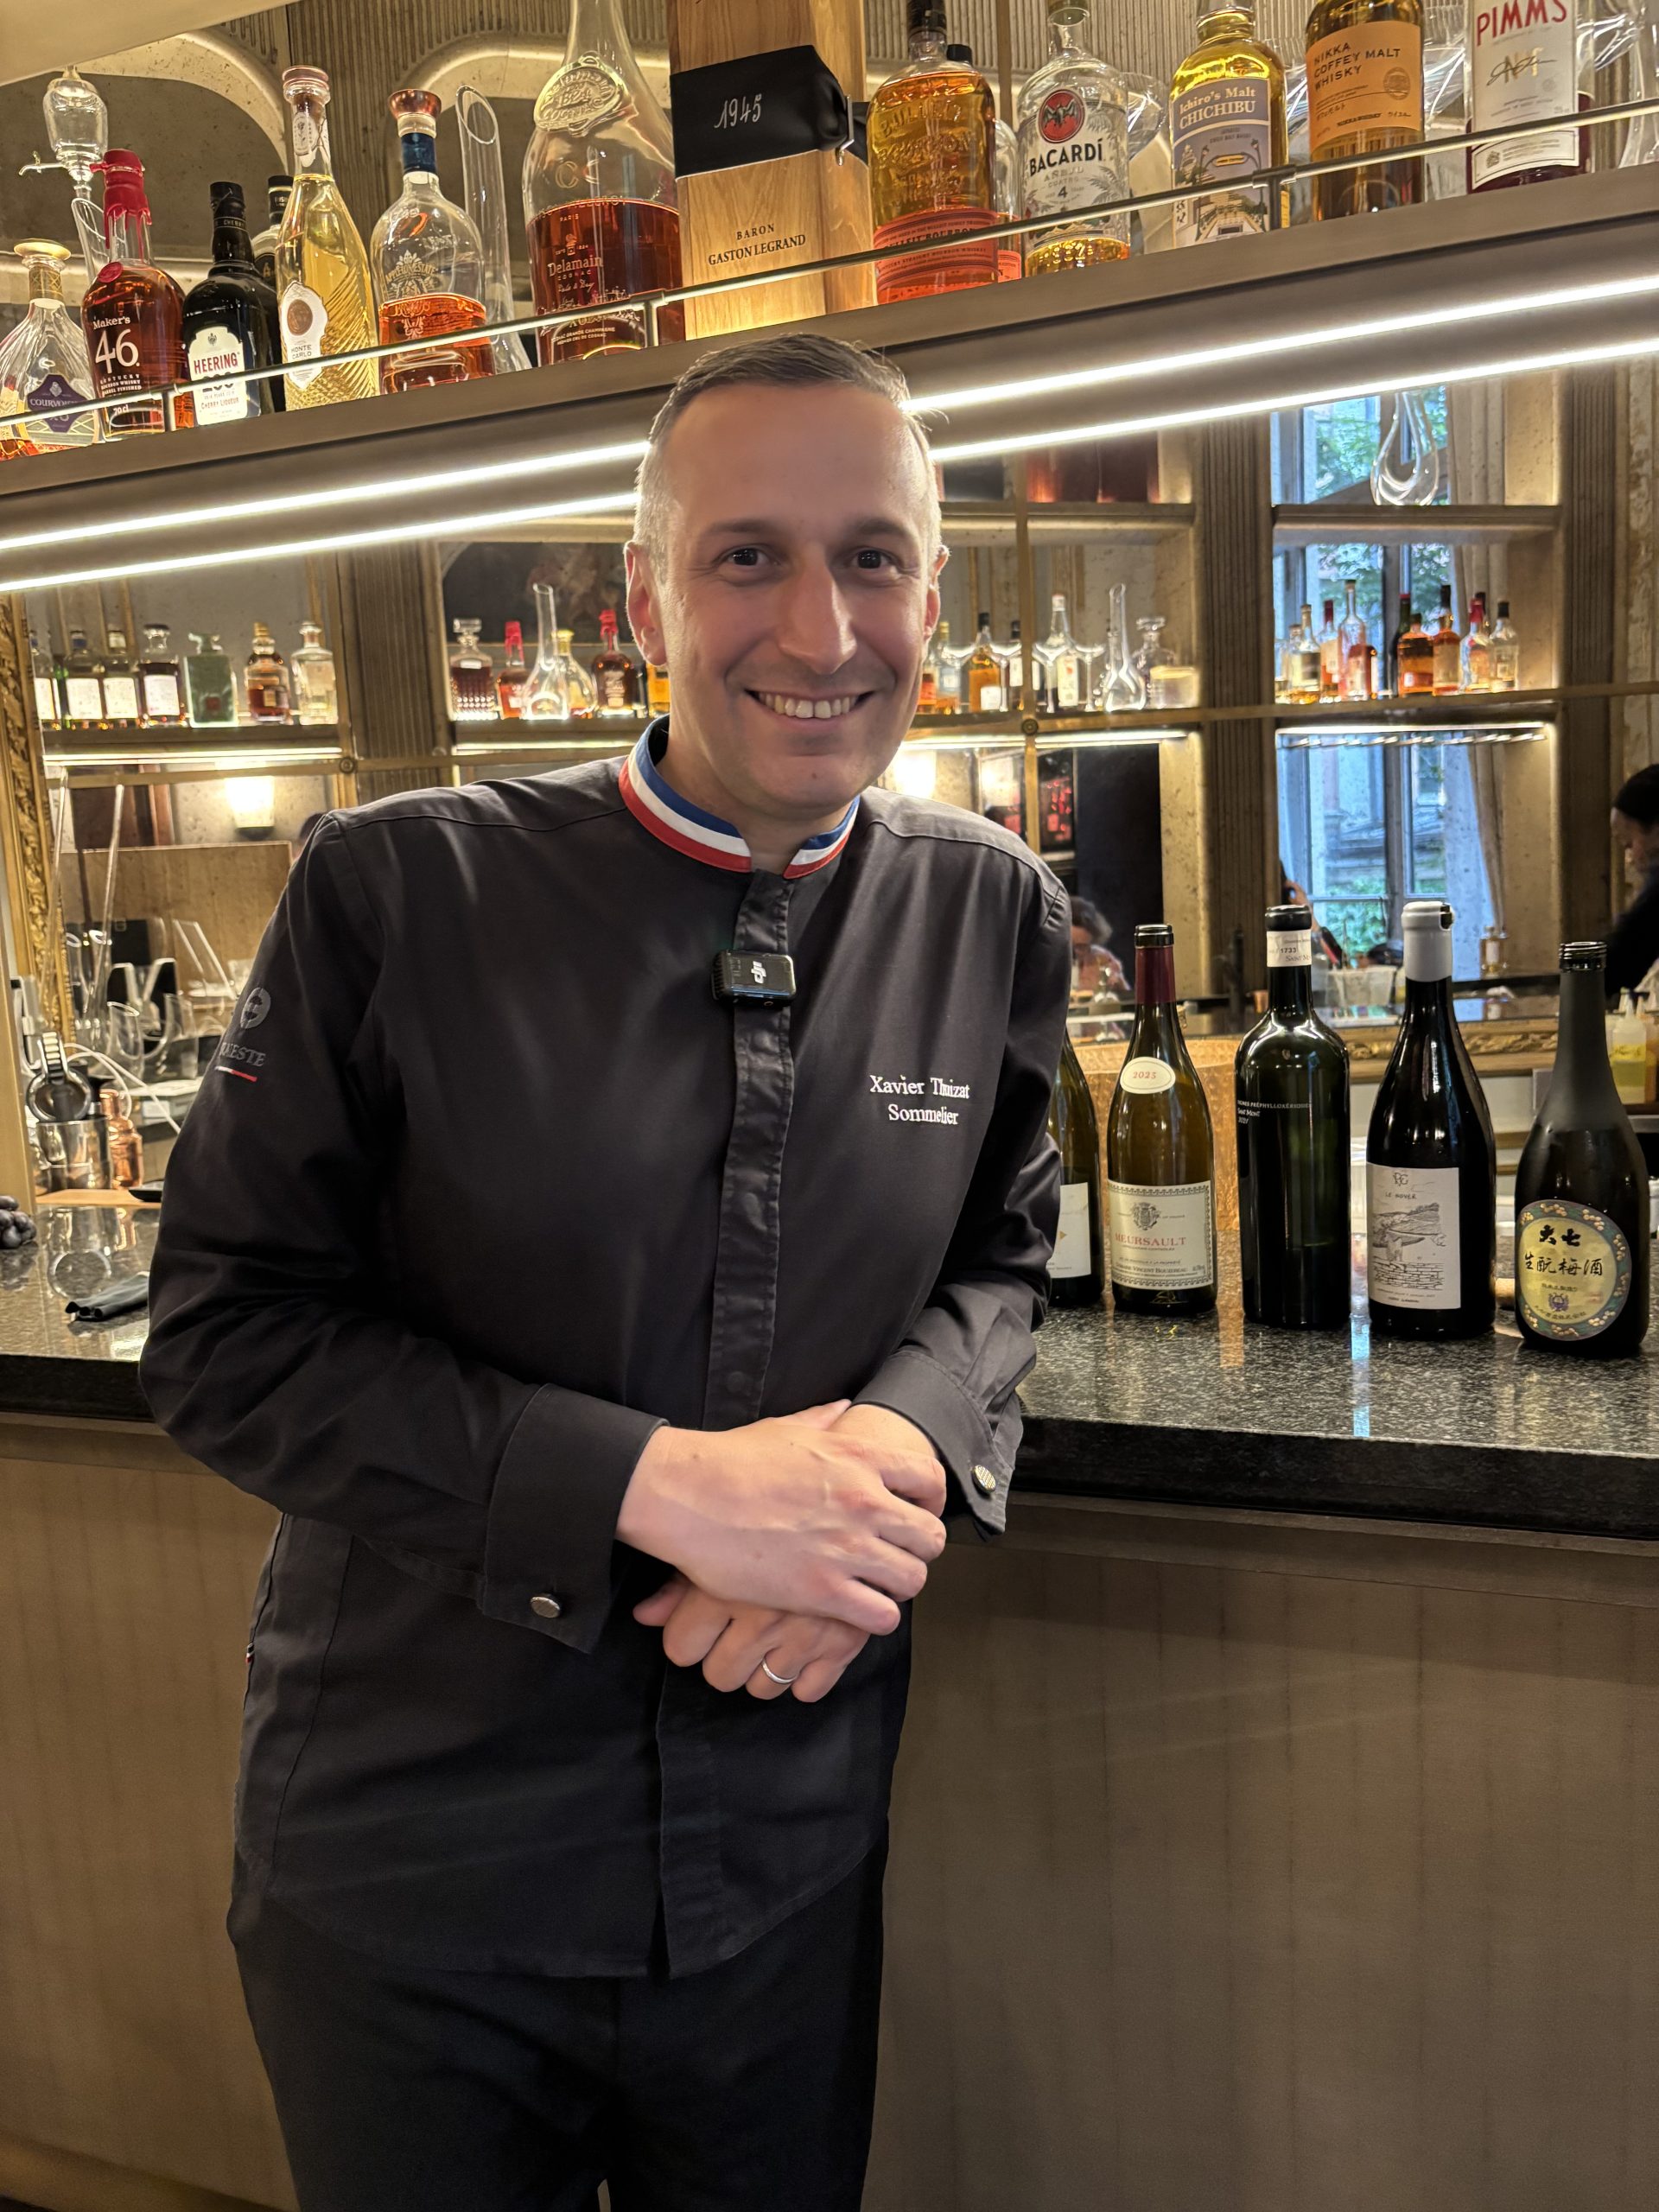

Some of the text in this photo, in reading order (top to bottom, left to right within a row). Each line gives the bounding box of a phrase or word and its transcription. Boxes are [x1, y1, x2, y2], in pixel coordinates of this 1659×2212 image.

[1314, 42, 1351, 66] NIKKA
[1314, 48, 1401, 78] COFFEY MALT
[1315, 65, 1362, 92] WHISKY
[714, 93, 762, 129] 1945
[1179, 86, 1256, 114] Ichiro's Malt
[1179, 100, 1256, 130] CHICHIBU
[1029, 138, 1103, 177] BACARDÍ
[1058, 186, 1068, 199] 4
[560, 213, 579, 222] PARIS
[736, 223, 775, 241] BARON
[708, 233, 806, 266] GASTON LEGRAND
[548, 255, 604, 277] Delamain
[93, 316, 131, 330] Maker's
[290, 344, 312, 353] MONTE
[292, 351, 312, 359] CARLO
[194, 352, 238, 374] HEERING
[870, 1074, 925, 1096] Xavier
[887, 1103, 959, 1125] Sommelier
[1115, 1233, 1186, 1246] MEURSAULT
[1539, 1224, 1582, 1247] 大七
